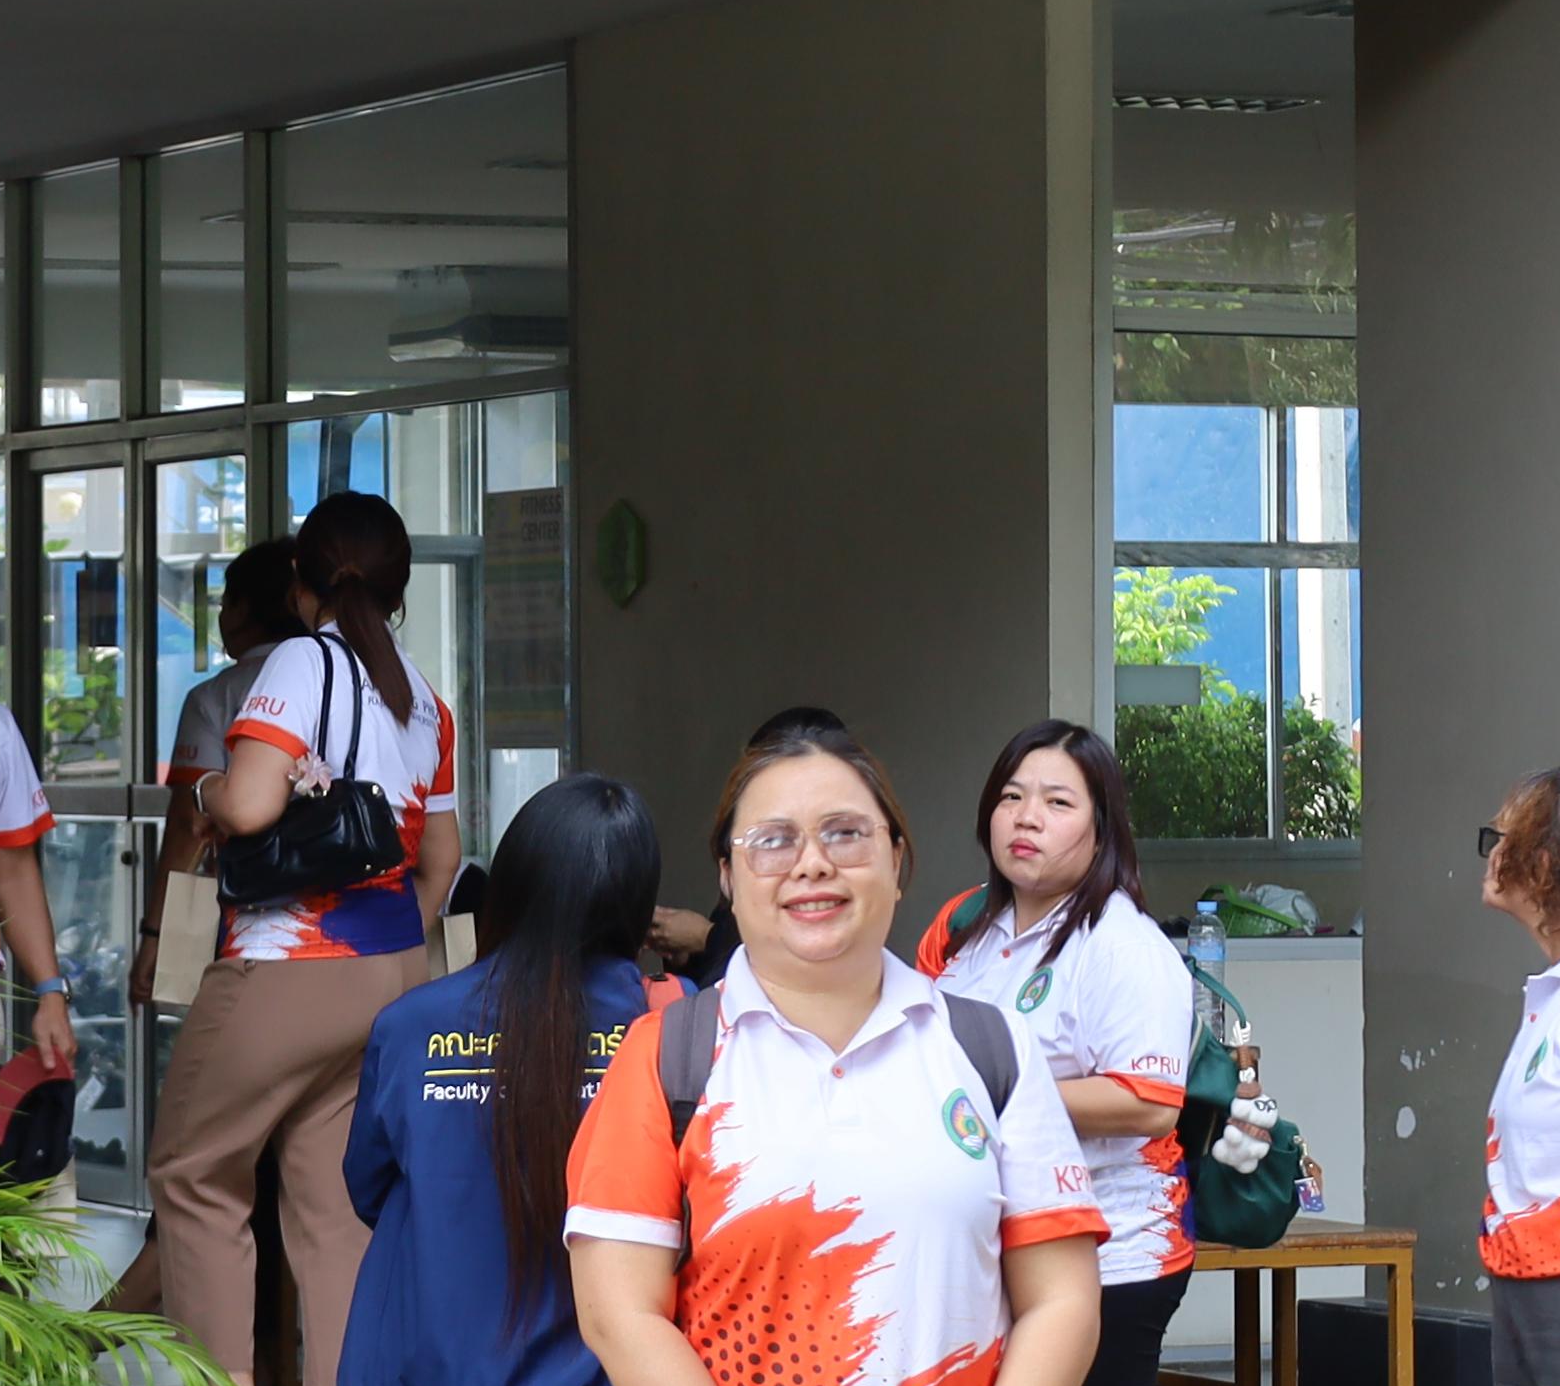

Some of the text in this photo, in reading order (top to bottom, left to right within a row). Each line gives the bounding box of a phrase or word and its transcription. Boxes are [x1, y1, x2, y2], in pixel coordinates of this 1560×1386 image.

[244, 695, 286, 716] PRU
[1131, 1054, 1181, 1075] KPRU
[423, 1081, 491, 1105] Faculty
